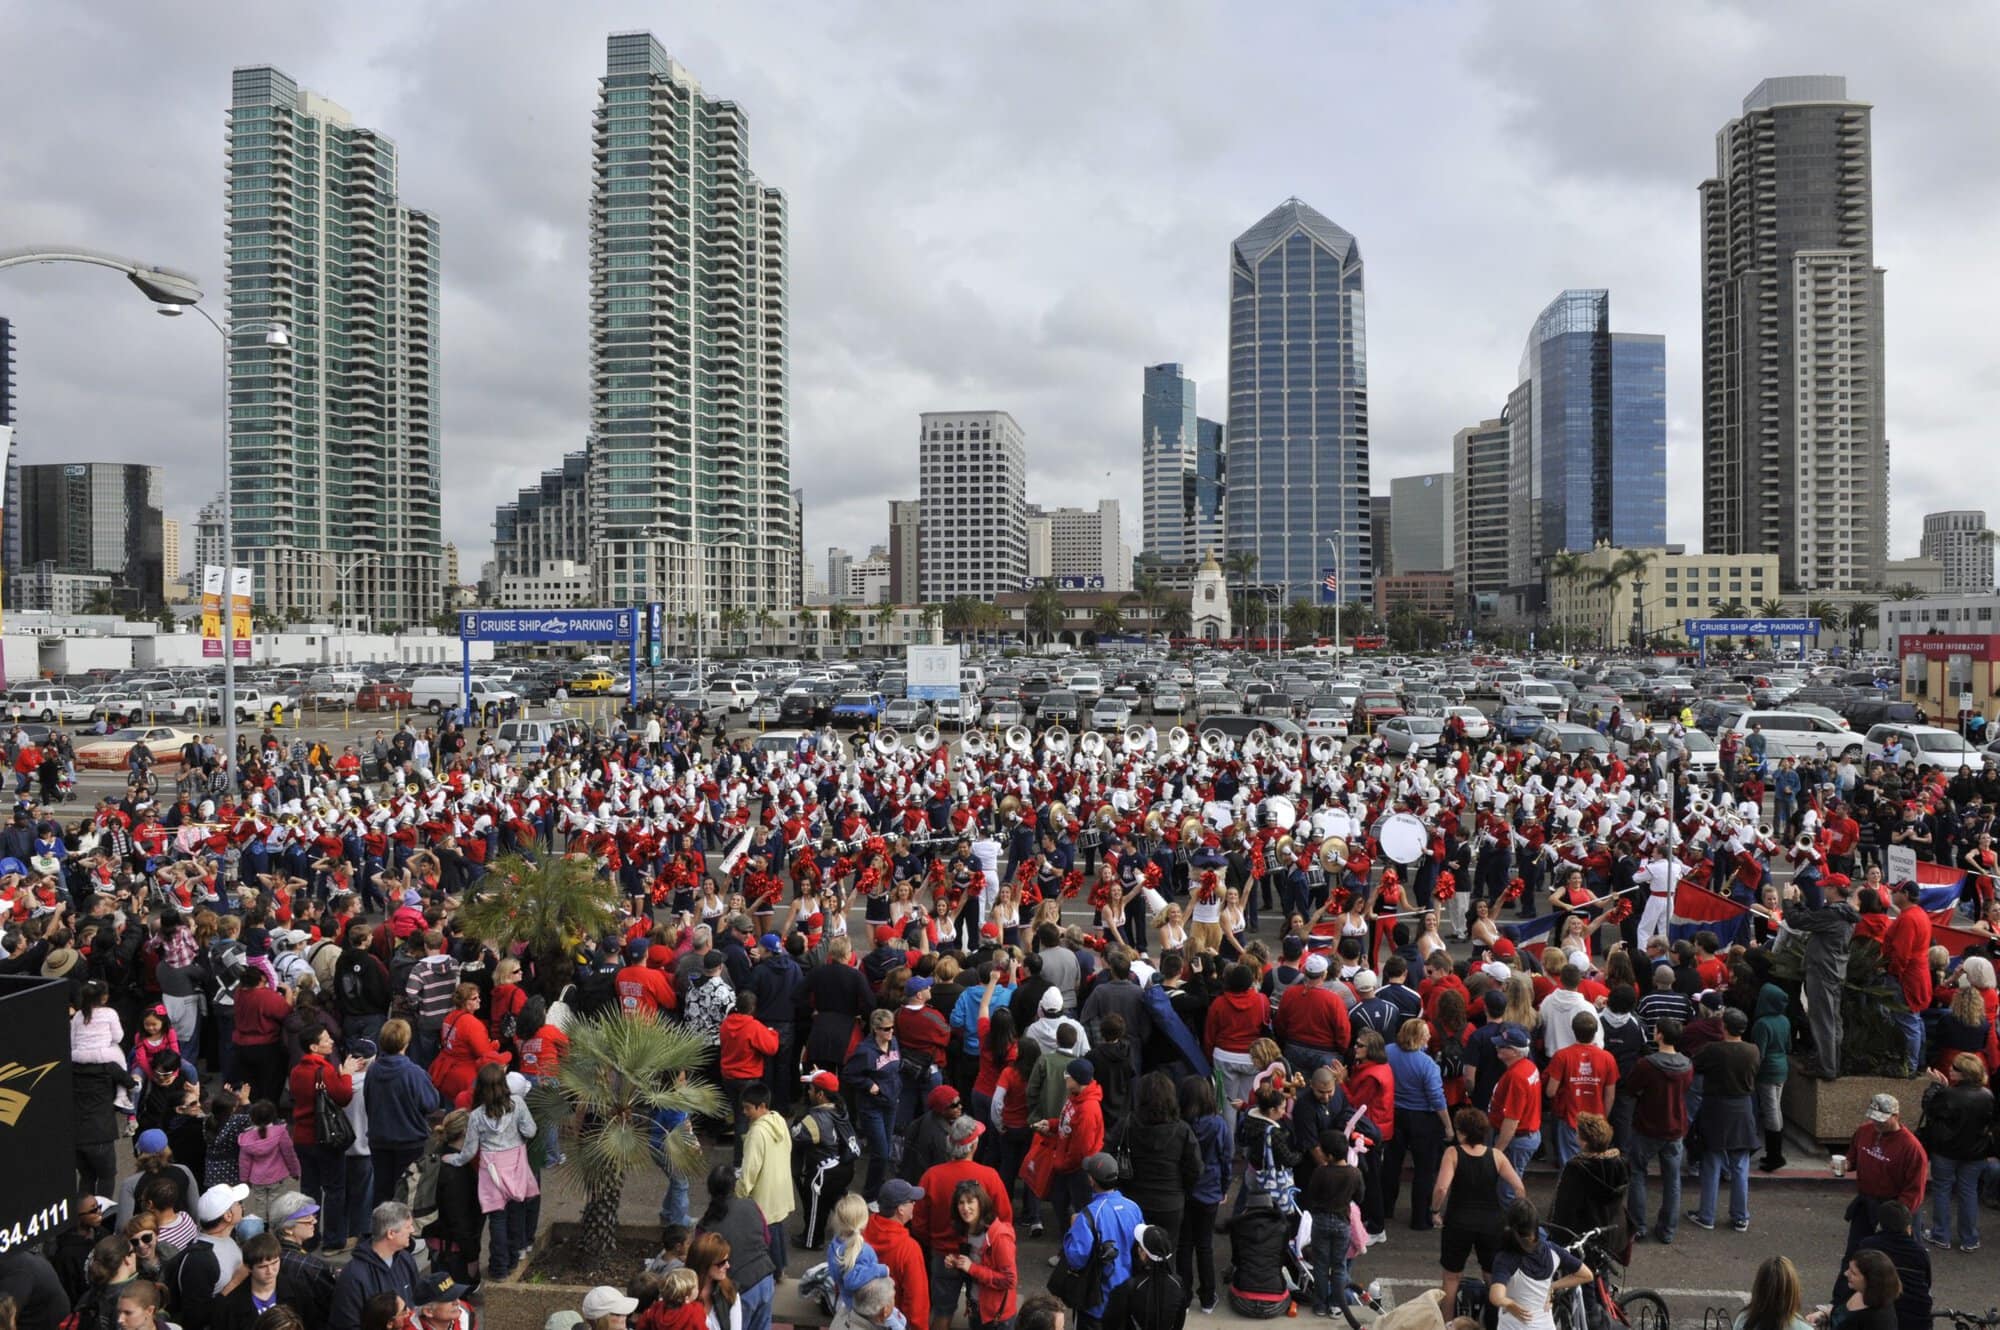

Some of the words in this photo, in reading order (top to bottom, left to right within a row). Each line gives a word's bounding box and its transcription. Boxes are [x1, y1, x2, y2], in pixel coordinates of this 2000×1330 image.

[1025, 577, 1074, 588] Sata
[1084, 577, 1101, 588] Fe
[464, 616, 475, 629] 5
[480, 619, 517, 632] CRUISE
[519, 619, 541, 631] SHIP
[569, 619, 614, 631] PARKING
[619, 615, 629, 628] 5
[1700, 623, 1729, 631] CRUISE
[1731, 623, 1748, 631] SHIP
[1770, 623, 1805, 631] PARKING
[1923, 642, 1944, 650] VISITOR
[1945, 643, 1984, 651] INFORMATION
[653, 645, 659, 662] P
[0, 1199, 68, 1253] 34.4111
